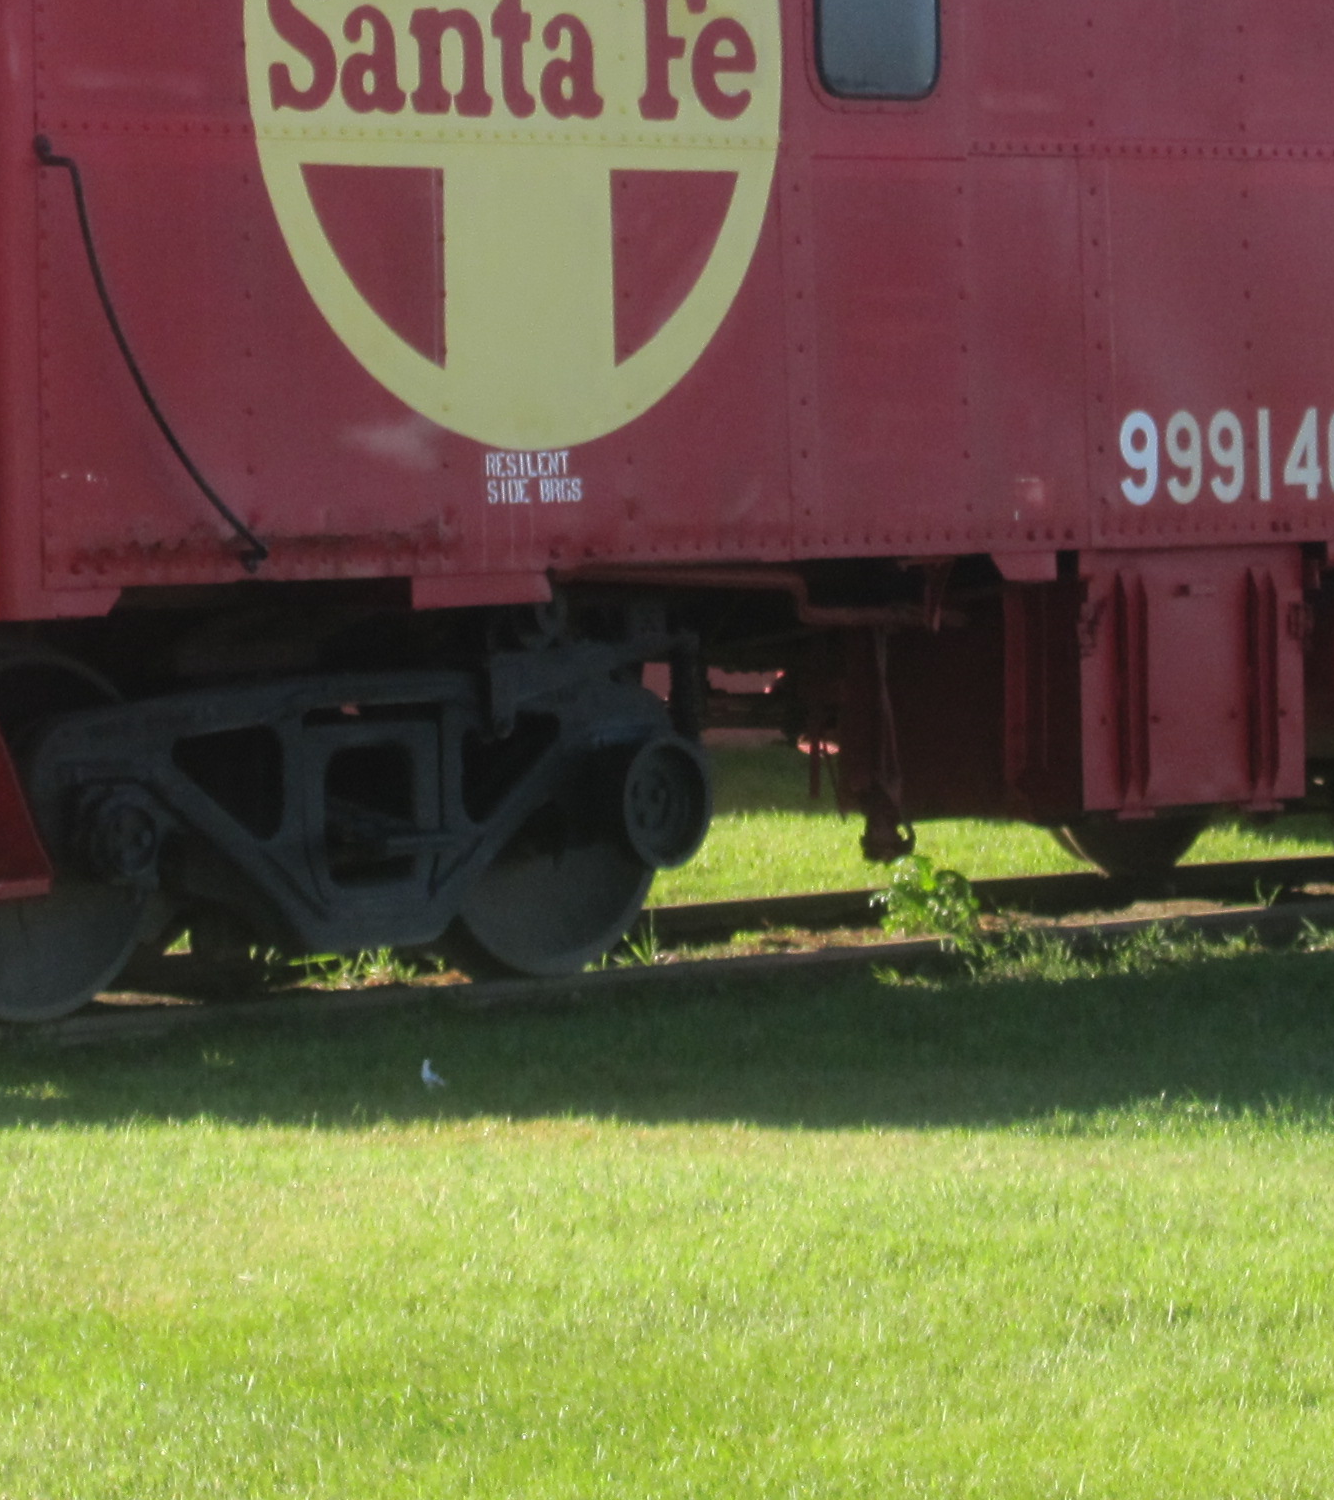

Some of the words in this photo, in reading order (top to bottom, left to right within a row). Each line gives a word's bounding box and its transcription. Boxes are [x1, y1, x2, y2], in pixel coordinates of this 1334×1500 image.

[485, 451, 569, 477] RESILENT
[487, 478, 531, 504] SIDE
[539, 478, 582, 503] BRGS
